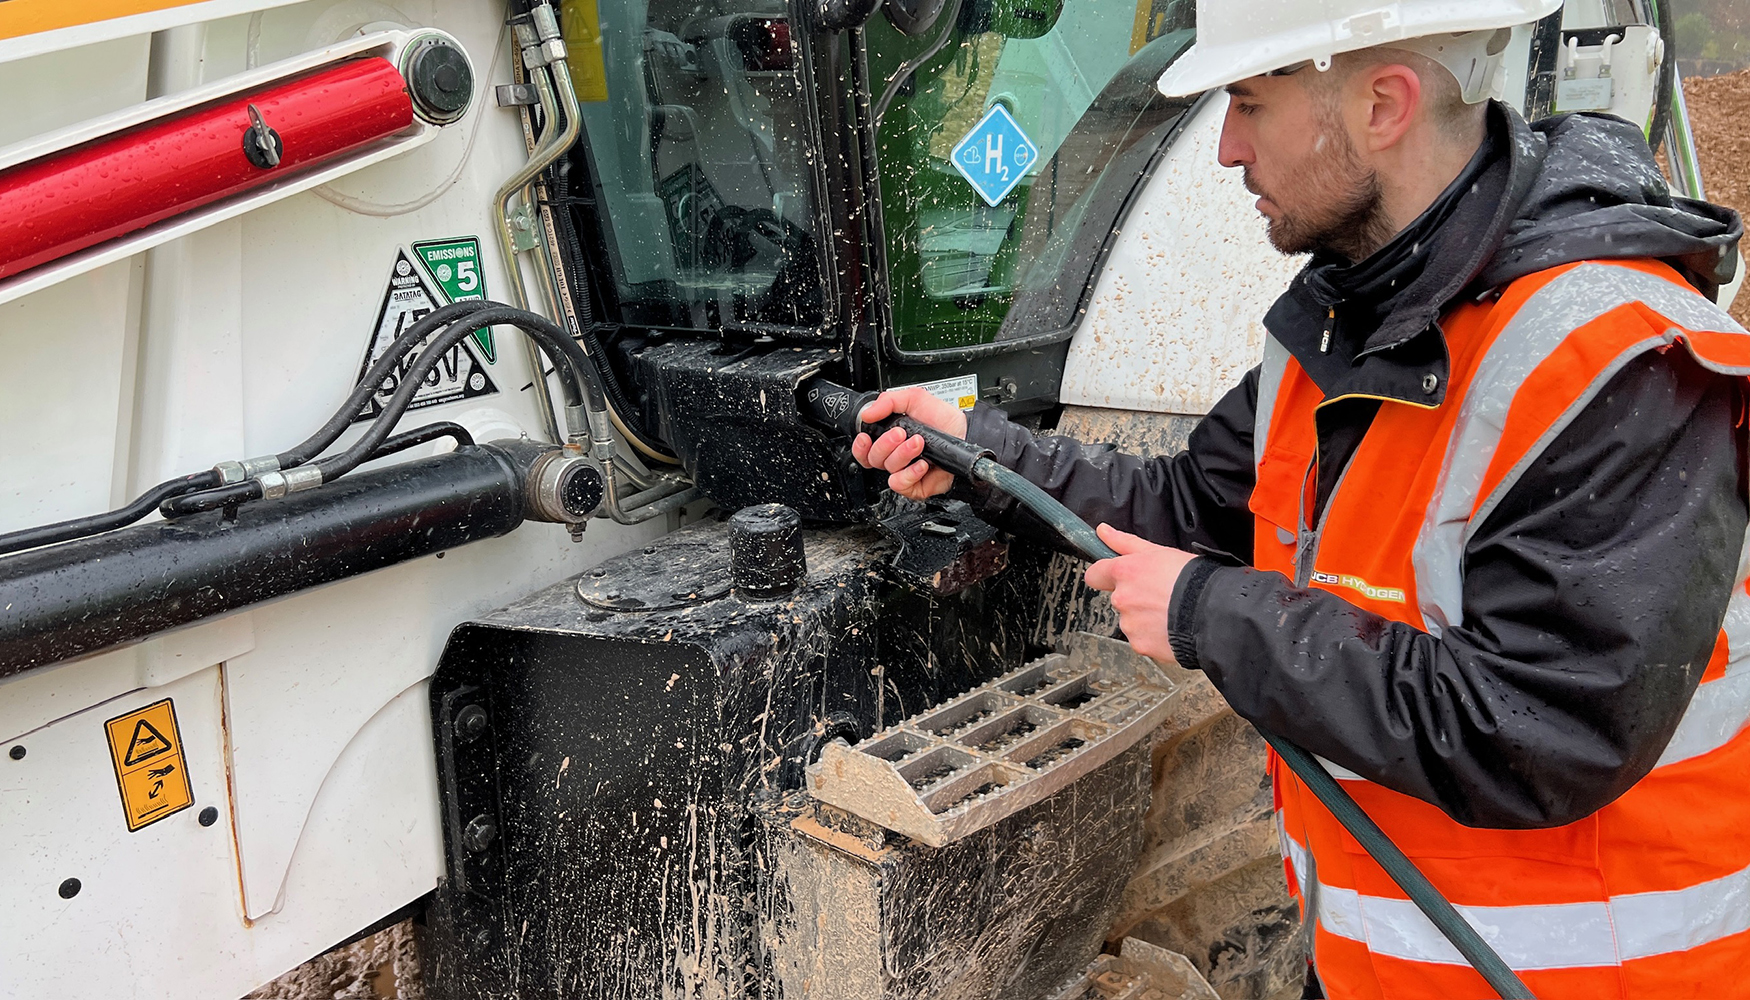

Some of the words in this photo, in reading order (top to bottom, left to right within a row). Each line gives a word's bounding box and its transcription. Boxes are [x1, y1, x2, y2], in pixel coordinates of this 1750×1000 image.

[427, 246, 474, 261] EMISSIONS
[391, 276, 419, 286] WARNING
[457, 260, 478, 292] 5
[1311, 571, 1338, 584] JCB
